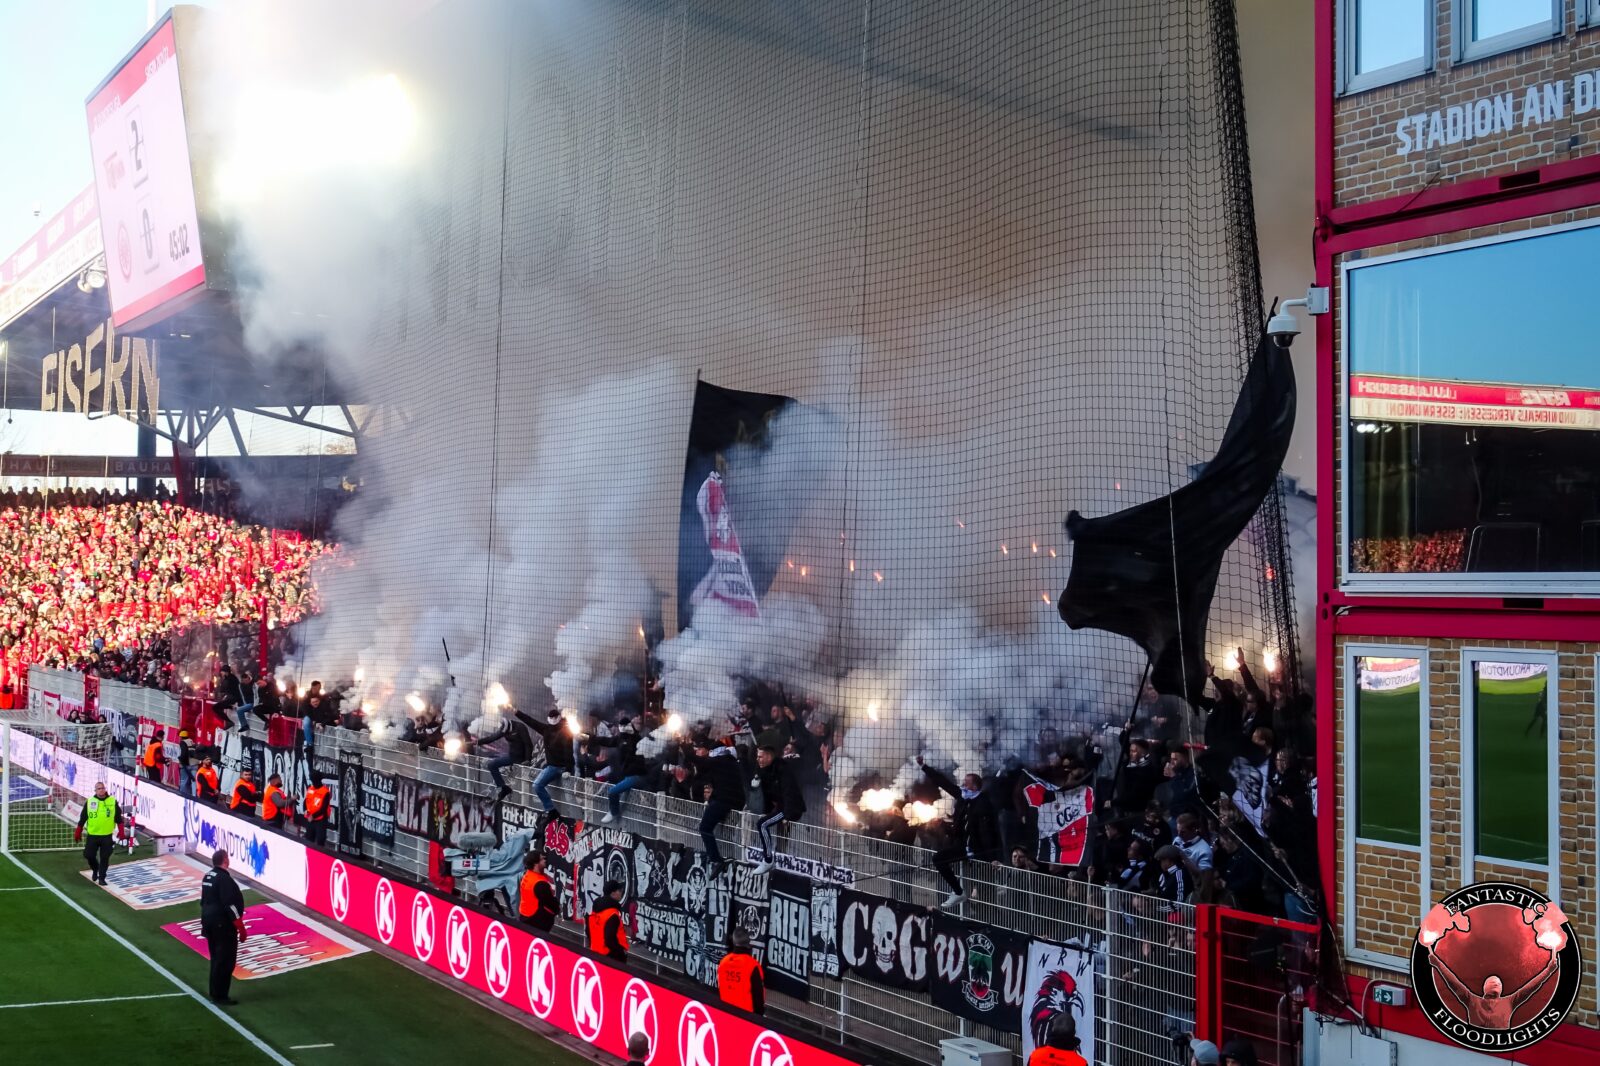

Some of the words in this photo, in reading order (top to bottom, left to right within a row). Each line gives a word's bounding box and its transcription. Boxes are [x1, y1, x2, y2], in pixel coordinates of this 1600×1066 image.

[1396, 92, 1514, 156] STADION
[1522, 80, 1564, 128] AN
[131, 120, 142, 172] 2
[142, 208, 154, 260] 0
[169, 223, 190, 263] 45:02
[115, 462, 173, 473] BAUHA
[769, 895, 809, 949] RIED
[767, 937, 809, 978] GEBIET
